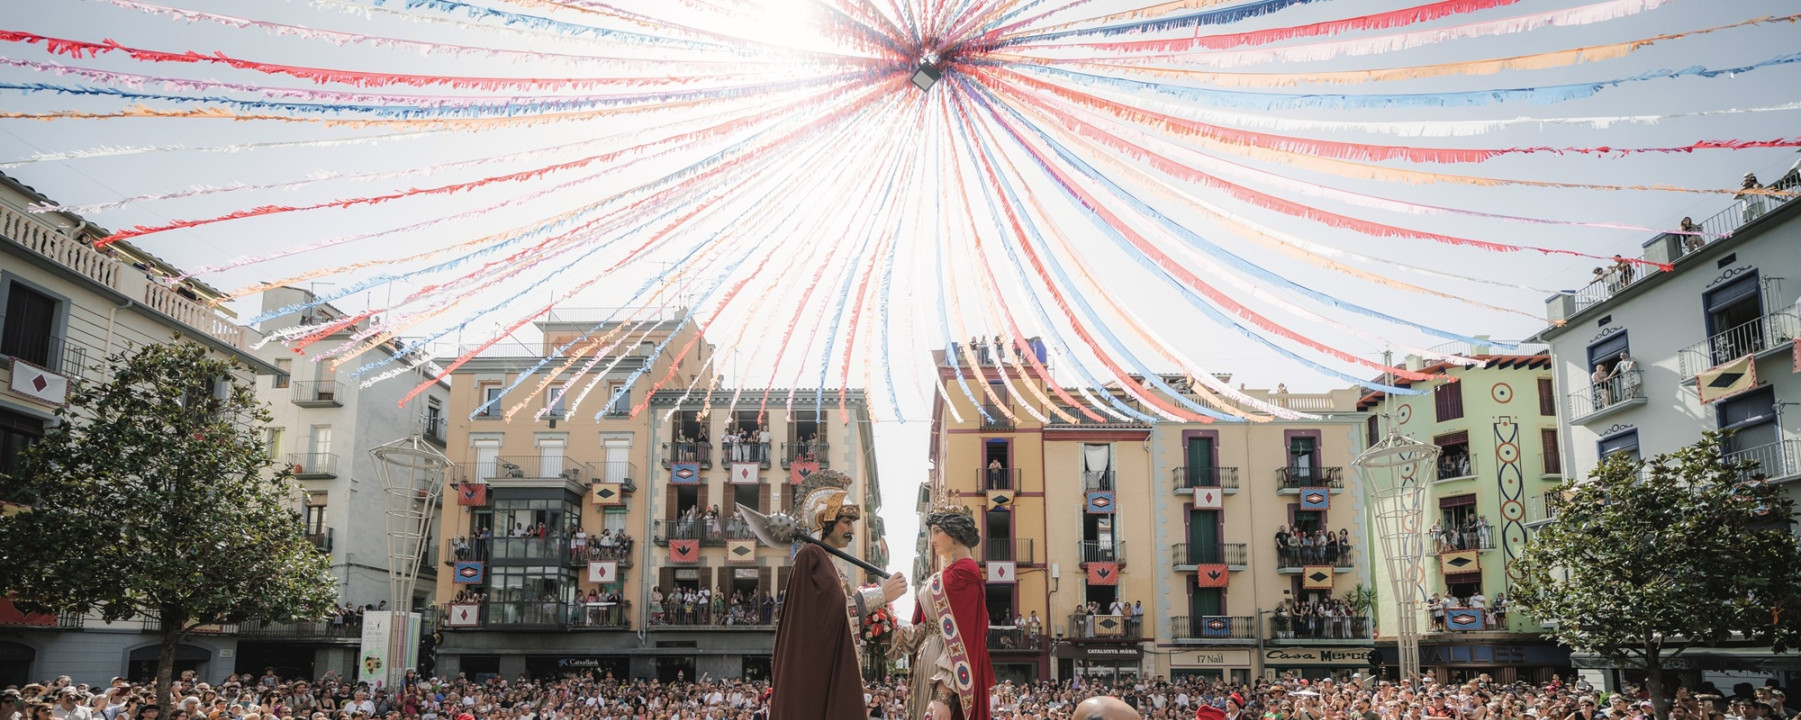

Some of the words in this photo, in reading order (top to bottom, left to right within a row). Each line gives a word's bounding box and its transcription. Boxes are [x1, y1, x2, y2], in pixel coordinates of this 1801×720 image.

[1197, 655, 1206, 663] 17
[1207, 652, 1224, 663] Nail
[1266, 650, 1316, 660] Casa
[570, 658, 598, 666] CaixaBank
